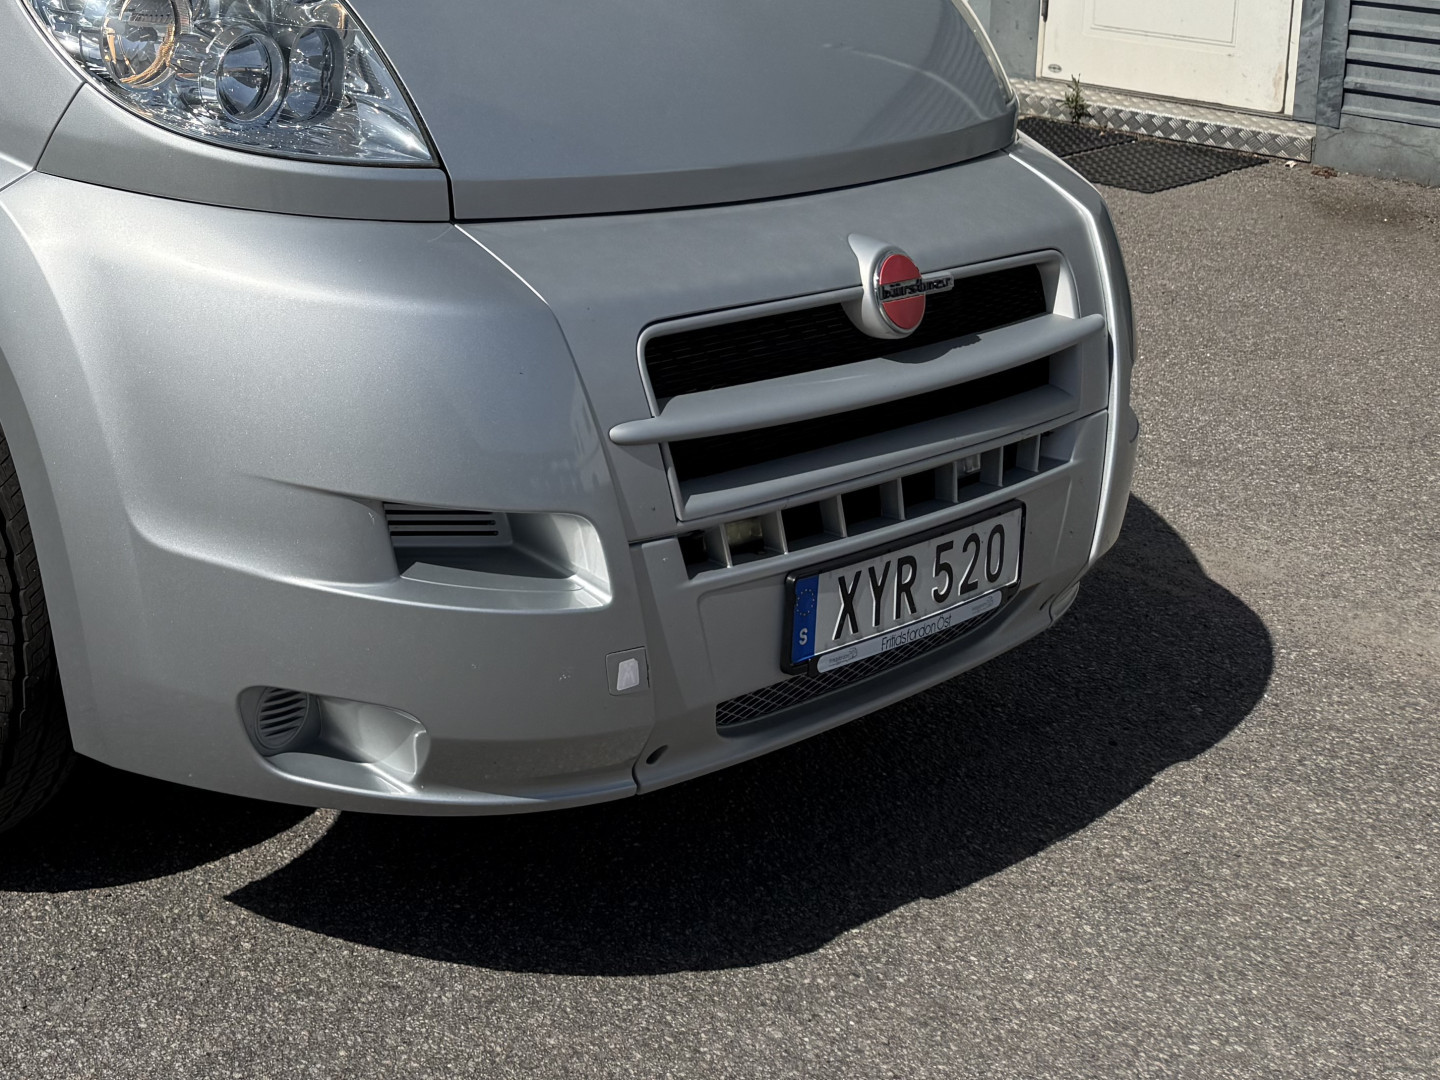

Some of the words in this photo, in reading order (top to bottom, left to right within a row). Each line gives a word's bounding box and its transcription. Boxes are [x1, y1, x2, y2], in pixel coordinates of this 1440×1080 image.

[832, 555, 918, 641] XYR
[931, 524, 1006, 604] 520
[798, 627, 809, 647] S
